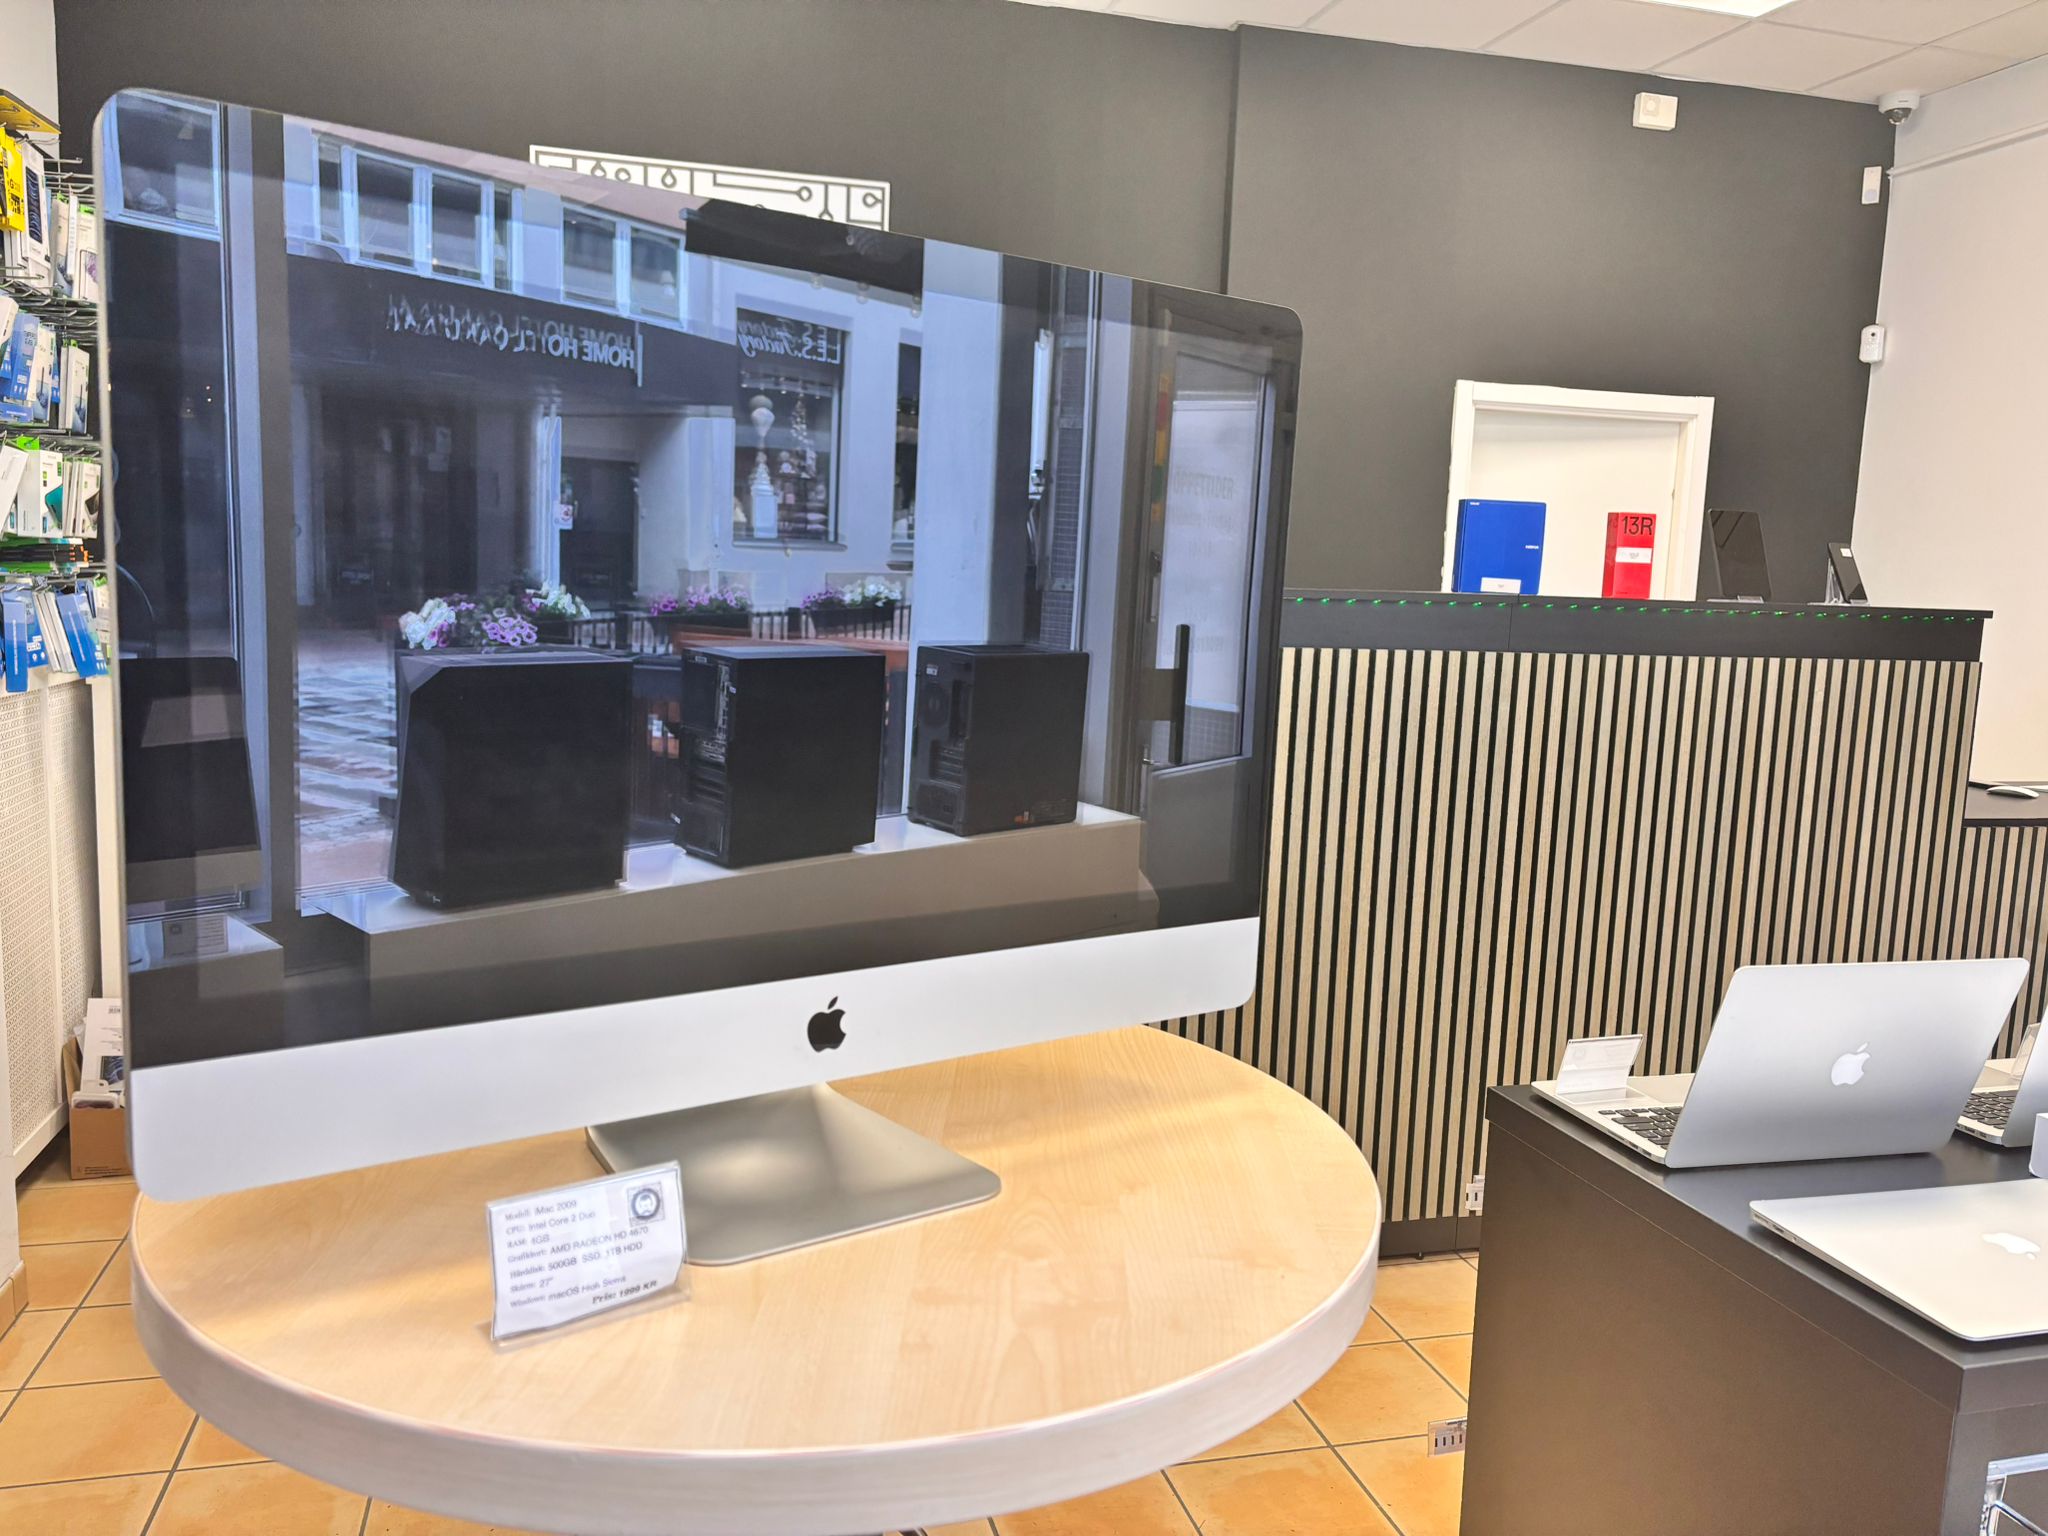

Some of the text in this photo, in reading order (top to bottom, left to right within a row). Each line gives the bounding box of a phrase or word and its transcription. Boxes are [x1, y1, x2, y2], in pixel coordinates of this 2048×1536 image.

[1621, 516, 1654, 536] 13R
[534, 1206, 554, 1216] iMac
[556, 1200, 577, 1211] 2009
[528, 1220, 547, 1231] Intel
[549, 1217, 569, 1228] Core
[569, 1213, 576, 1222] 2
[578, 1210, 596, 1221] Duo
[549, 1243, 571, 1255] AMD
[572, 1235, 612, 1251] RADEON
[614, 1231, 627, 1242] HD
[547, 1257, 577, 1272] 500GB
[624, 1241, 643, 1254] HDD
[548, 1286, 580, 1301] macOS
[581, 1281, 601, 1294] High
[592, 1280, 657, 1304] Pris: 1999 KR
